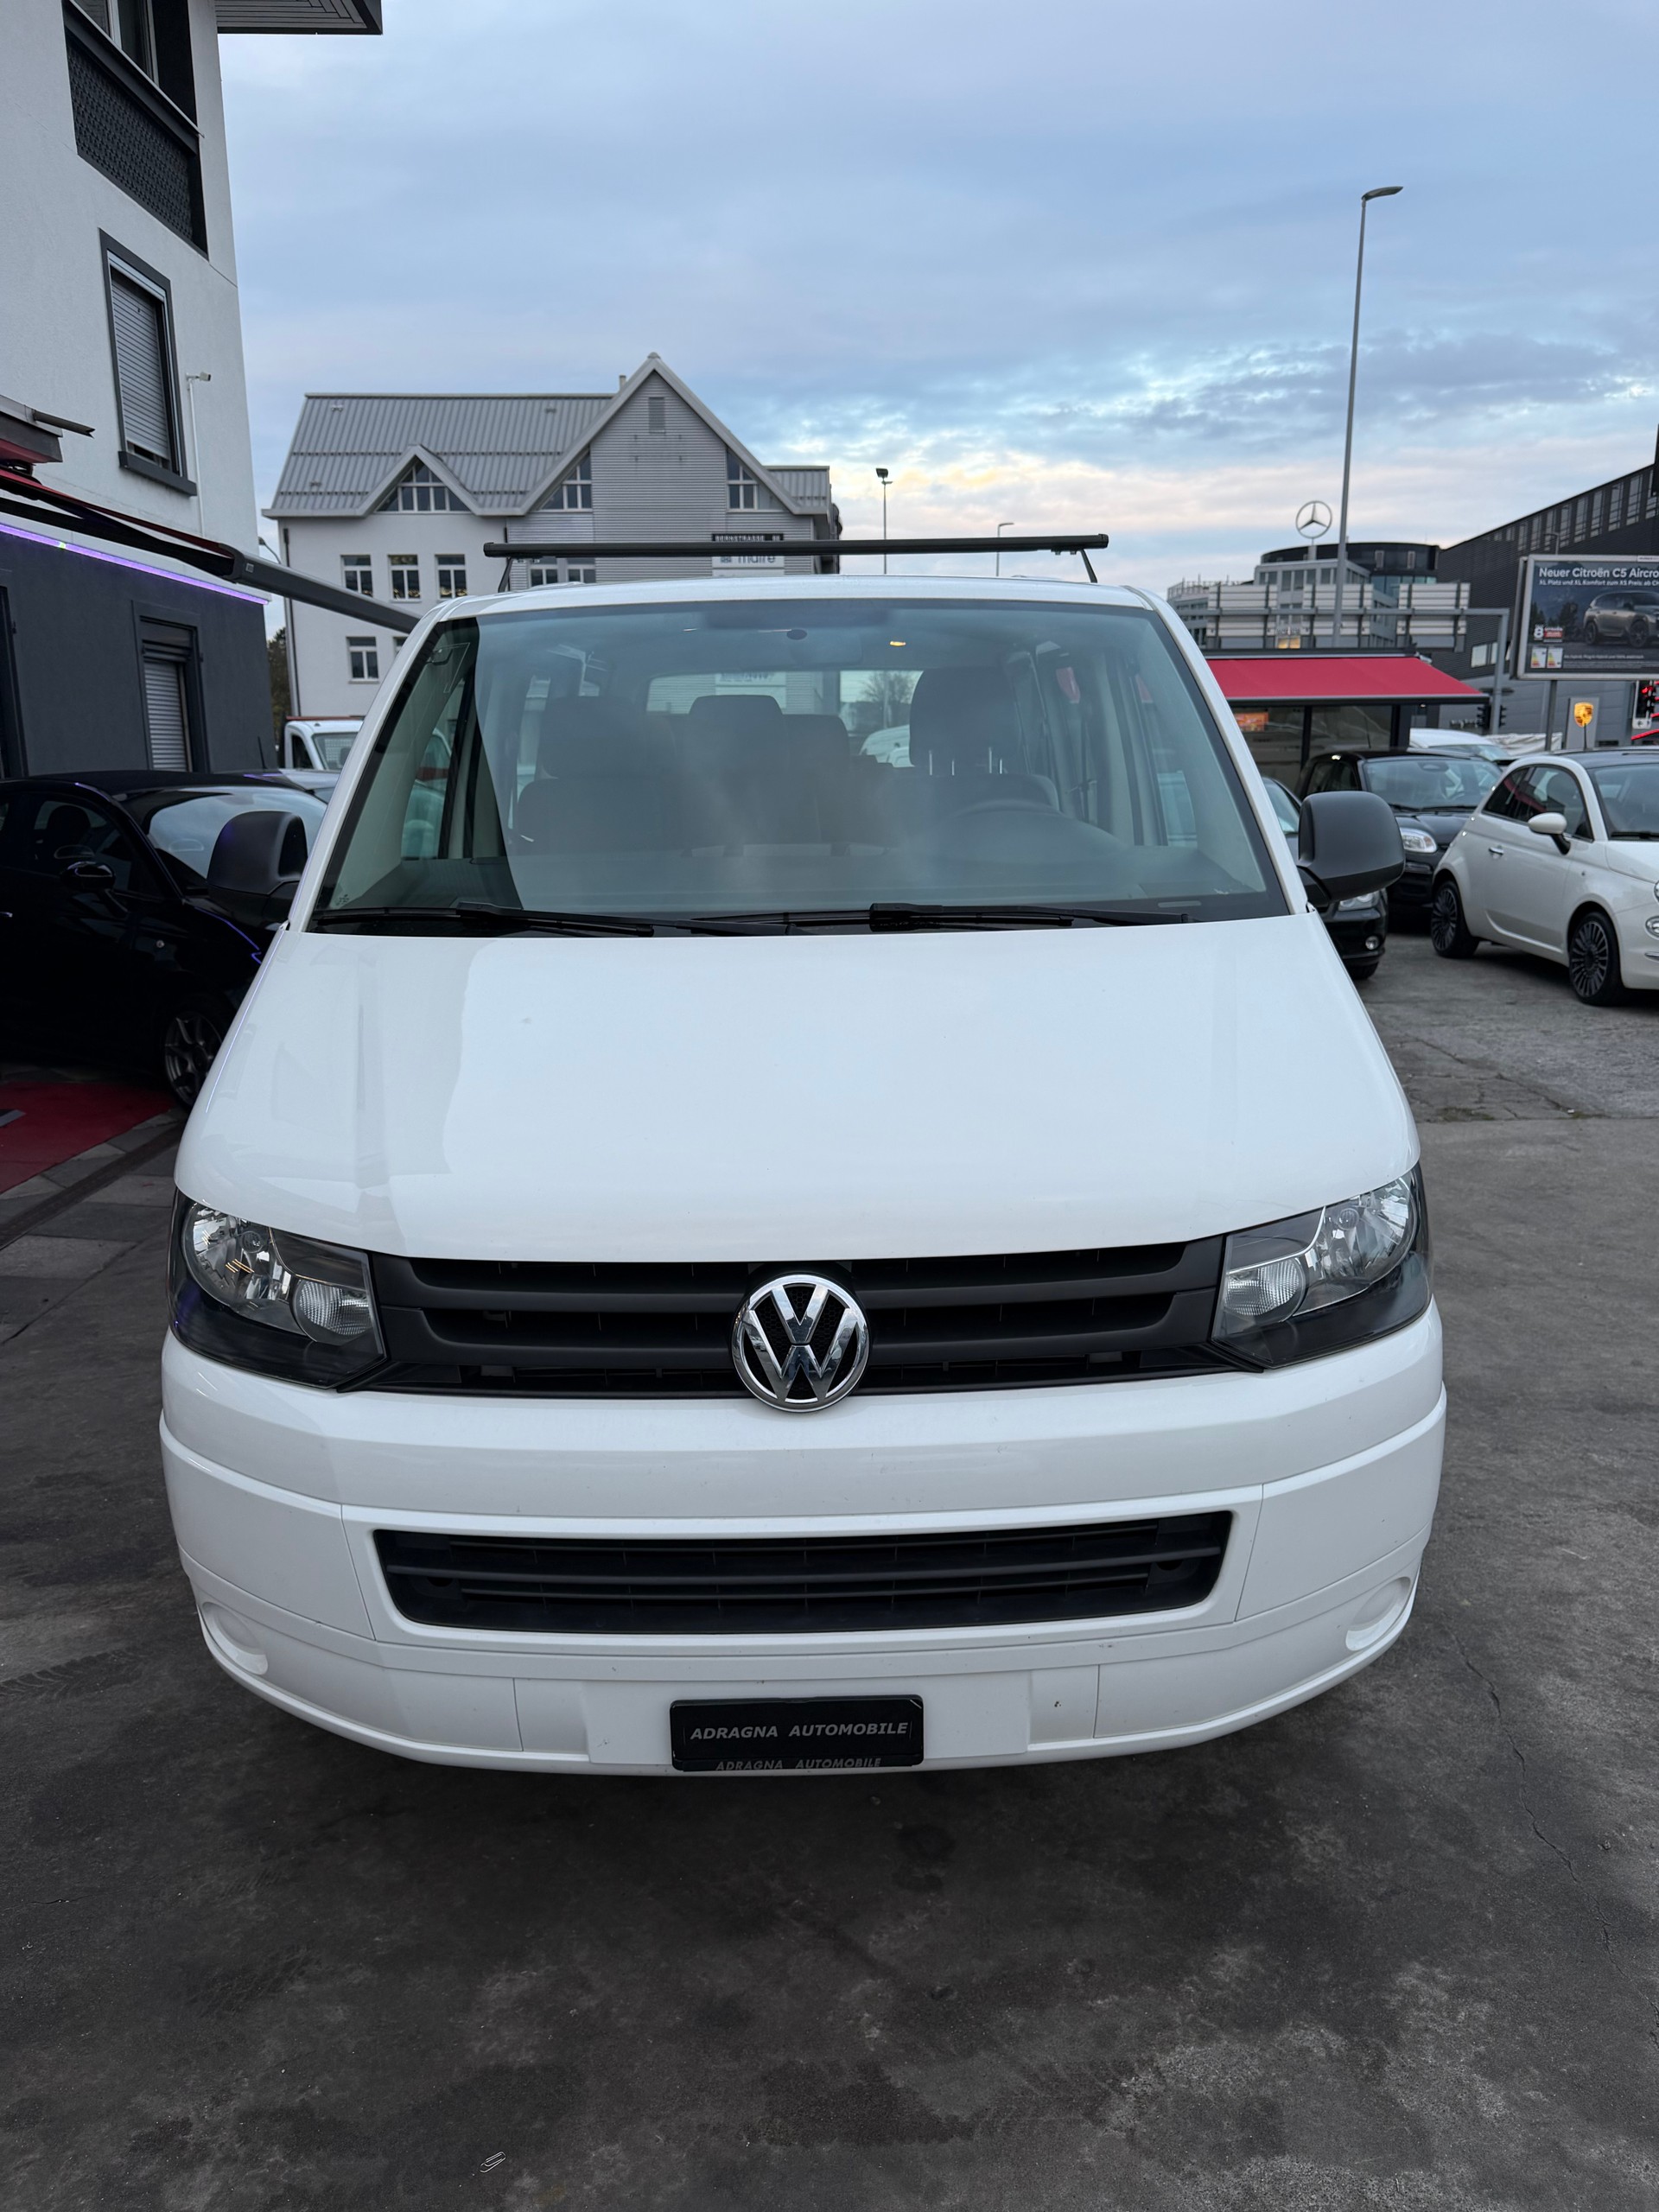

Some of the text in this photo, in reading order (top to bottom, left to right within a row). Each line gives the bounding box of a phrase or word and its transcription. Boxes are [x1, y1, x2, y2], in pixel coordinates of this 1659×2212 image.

[1539, 567, 1570, 578] Neuer
[1572, 567, 1610, 578] Citroën
[1611, 568, 1627, 578] C5
[739, 1282, 863, 1404] VW
[690, 1722, 908, 1740] ADRAGNA AUTOMOBILE
[715, 1758, 881, 1770] ADRAGNA AUTOMOBILE
